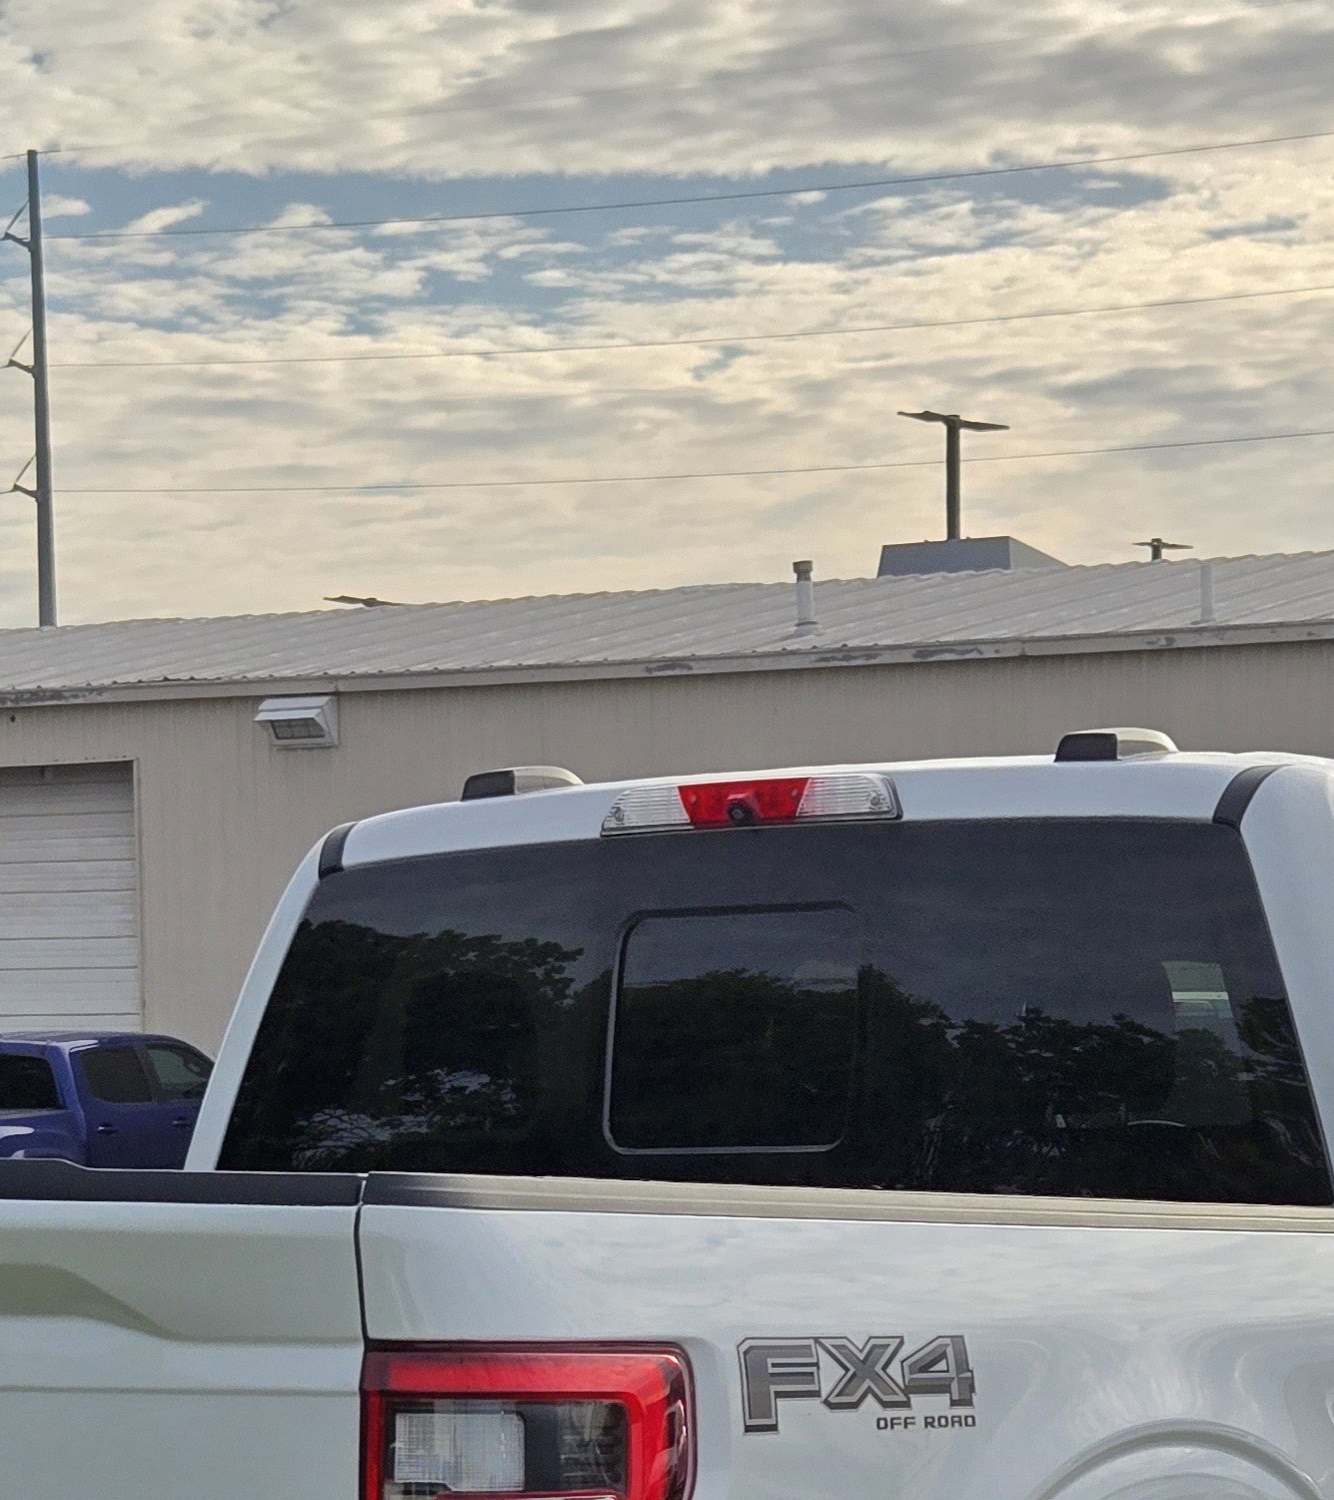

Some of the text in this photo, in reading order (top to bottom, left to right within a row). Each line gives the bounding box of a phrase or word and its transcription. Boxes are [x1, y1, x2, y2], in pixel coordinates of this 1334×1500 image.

[736, 1334, 976, 1435] FX4
[875, 1414, 977, 1430] OFF ROAD
